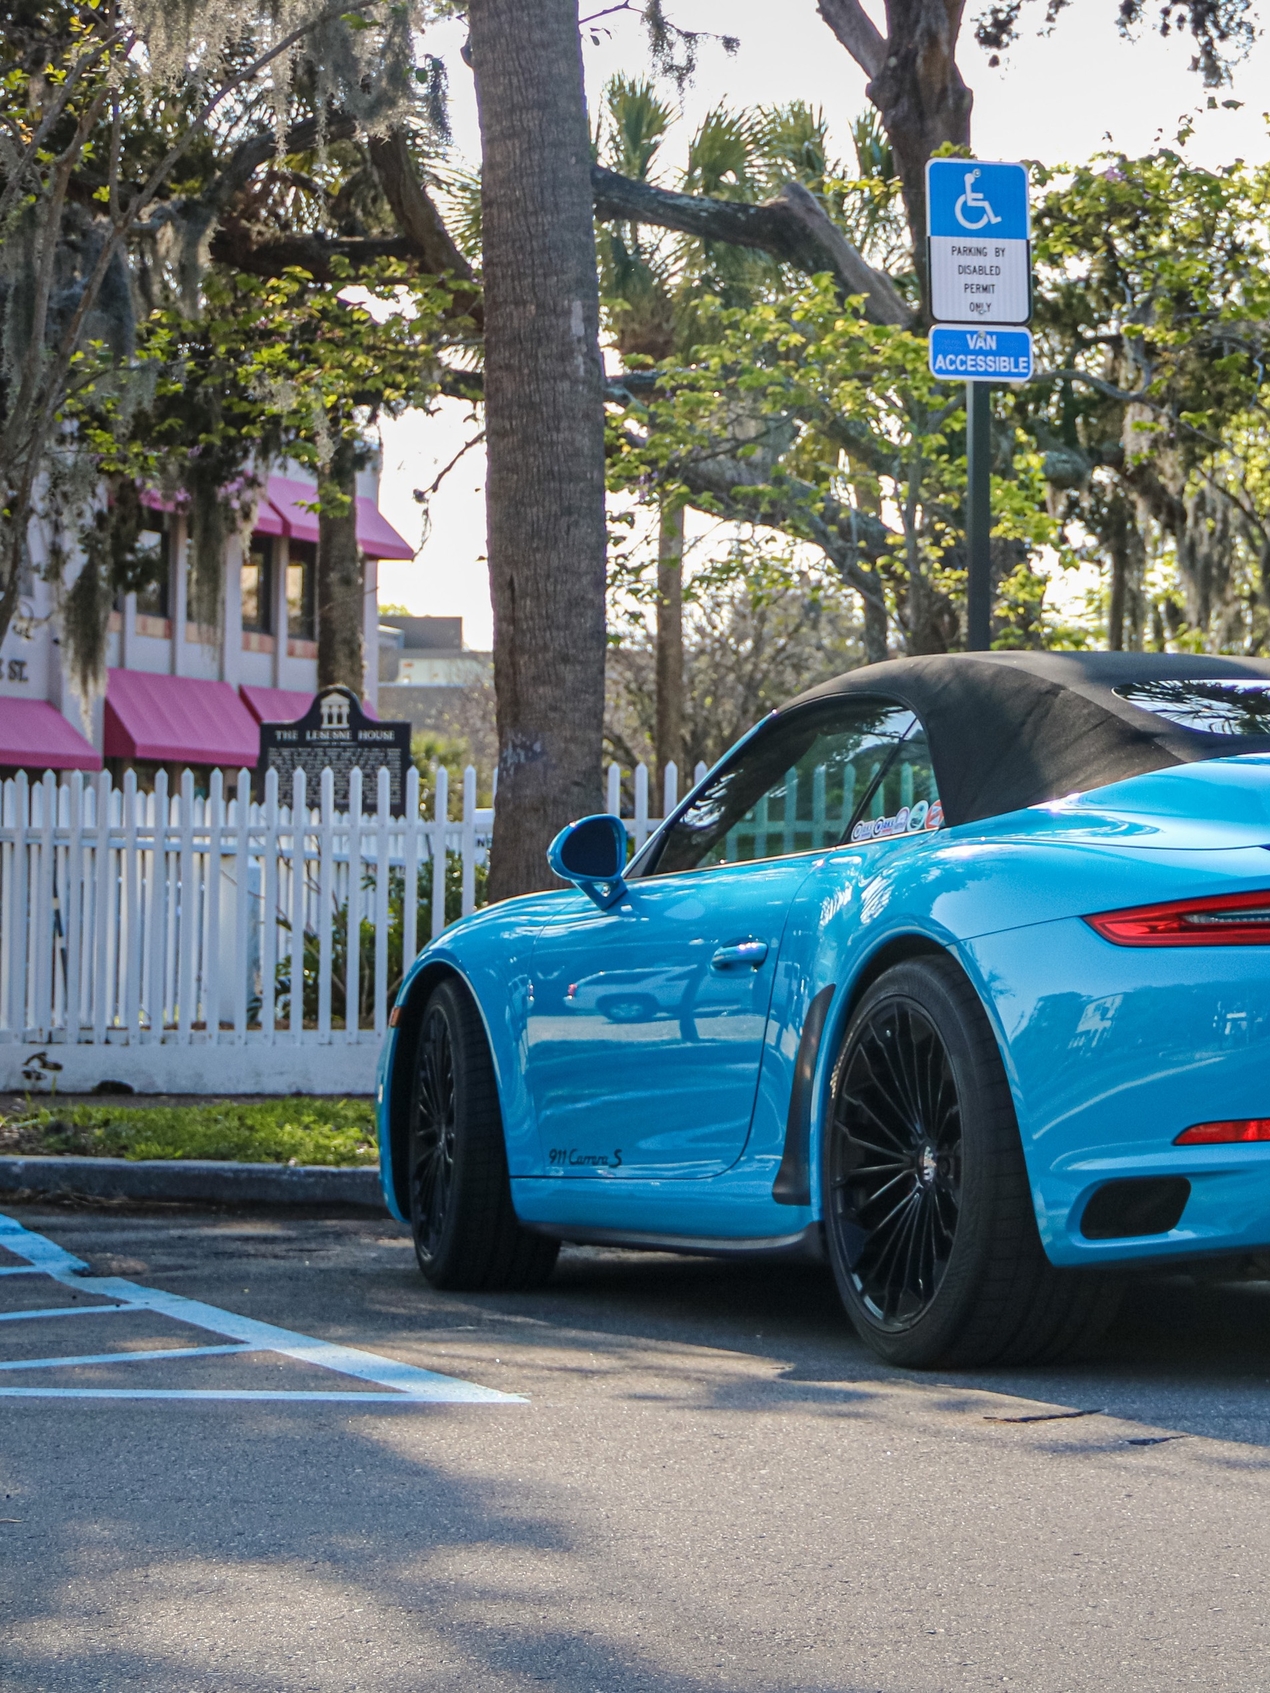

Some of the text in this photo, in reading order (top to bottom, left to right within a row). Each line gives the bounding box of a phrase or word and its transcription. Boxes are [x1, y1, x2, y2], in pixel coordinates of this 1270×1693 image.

[951, 245, 1006, 257] PARKING BY
[957, 264, 1001, 276] DISABLED
[963, 283, 996, 294] PERMIT
[969, 302, 992, 313] ONLY
[966, 333, 997, 350] VAN
[934, 354, 1029, 373] ACCESSIBLE
[275, 730, 396, 742] THE LESESNE HOUSE
[549, 1148, 622, 1168] 911 Carrera S
